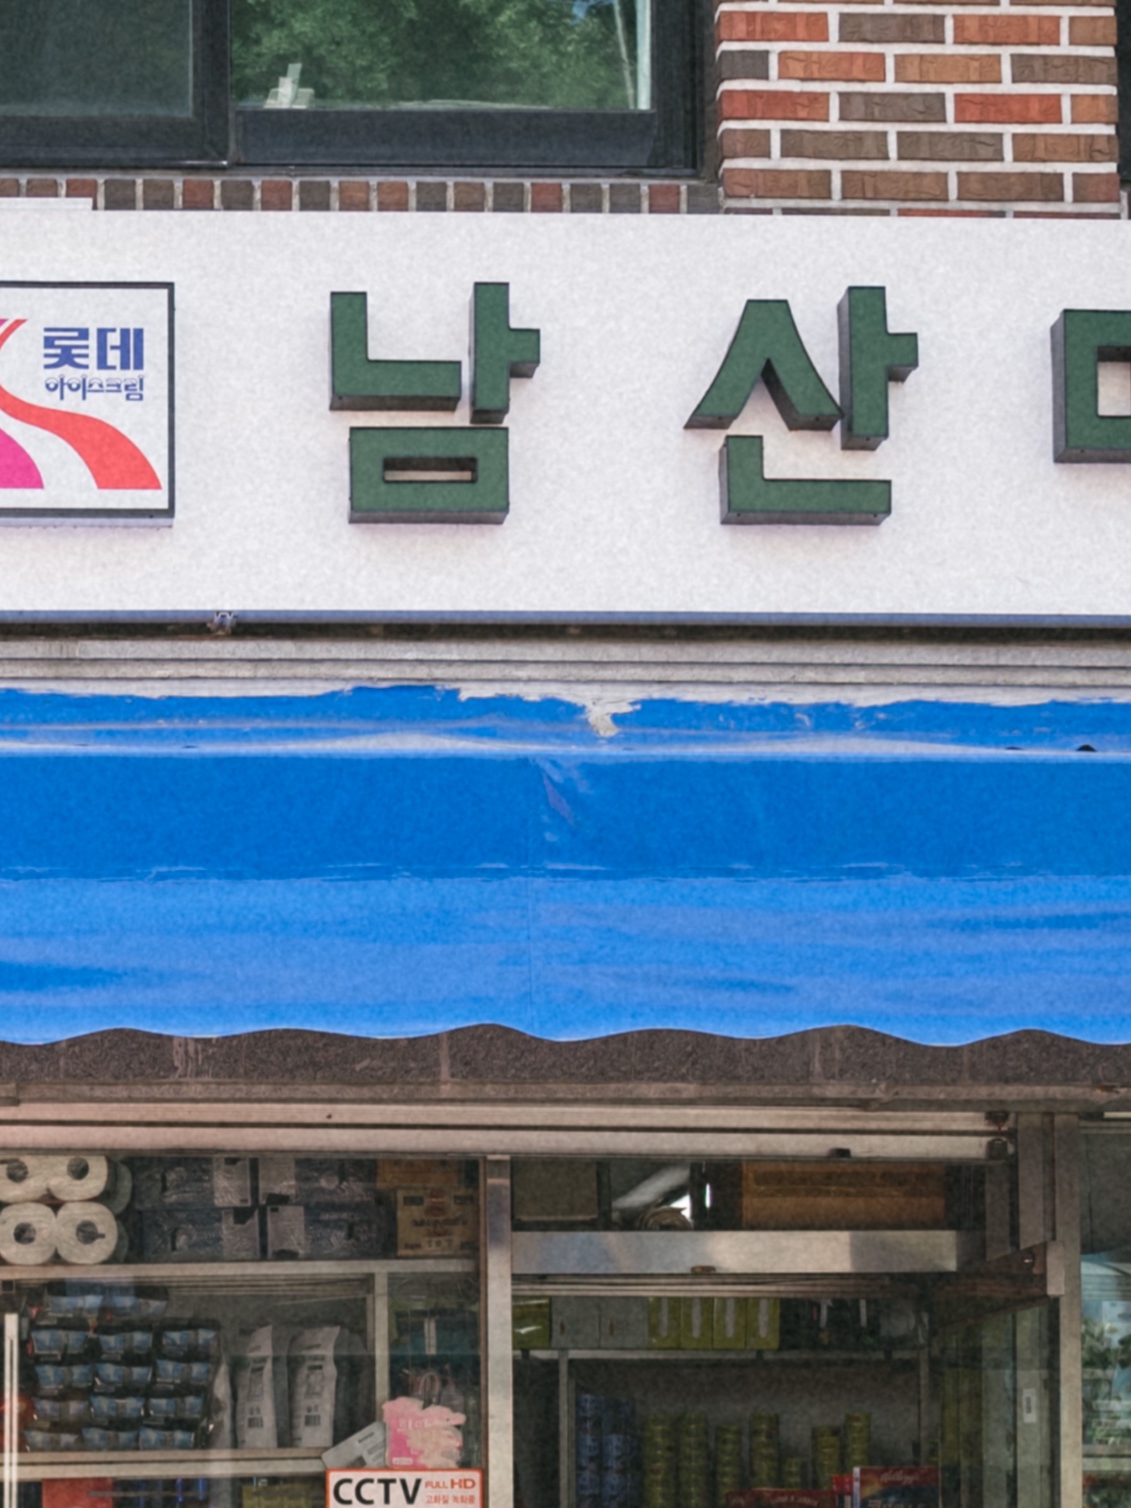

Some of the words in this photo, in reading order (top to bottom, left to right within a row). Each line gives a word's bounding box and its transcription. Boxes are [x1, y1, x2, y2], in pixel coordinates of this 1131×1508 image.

[43, 326, 144, 371] 롯데
[44, 373, 145, 402] 아이스크림
[333, 1478, 422, 1505] CCTV
[424, 1480, 448, 1489] FULL
[450, 1478, 476, 1489] HD
